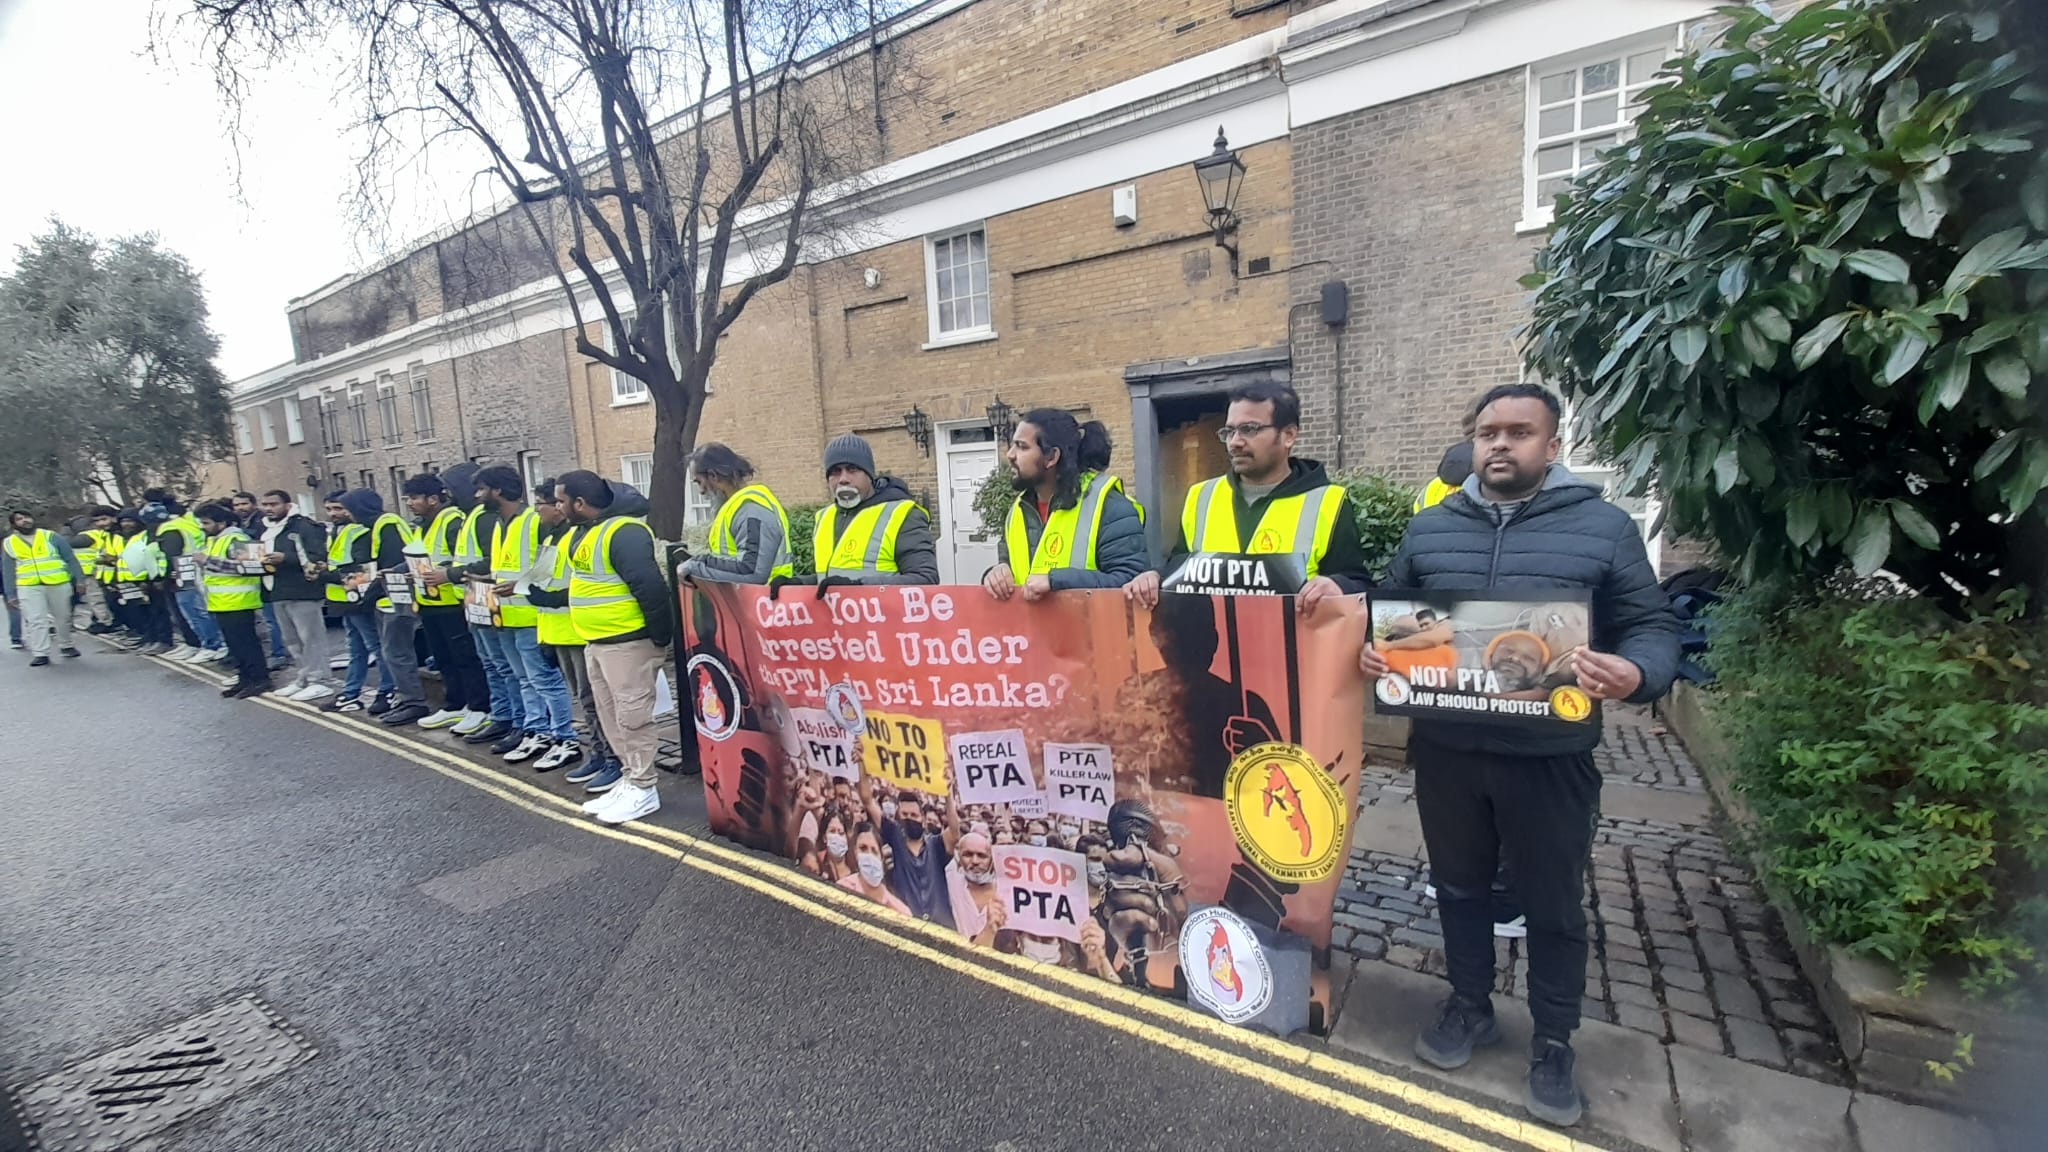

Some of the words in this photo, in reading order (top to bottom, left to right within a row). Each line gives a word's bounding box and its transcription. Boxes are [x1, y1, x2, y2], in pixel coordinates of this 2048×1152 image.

[1184, 558, 1223, 584] NOT
[1227, 559, 1269, 586] PTA
[756, 596, 813, 628] Can
[823, 592, 886, 625] You
[900, 587, 954, 623] Be
[896, 629, 1029, 666] Under
[776, 668, 831, 698] PTA
[929, 674, 1071, 709] Lanka?
[1409, 665, 1448, 688] NOT
[1457, 668, 1500, 693] PTA
[1409, 691, 1436, 707] LAW
[1436, 693, 1487, 712] SHOULD
[1490, 698, 1550, 716] PROTECT
[865, 717, 891, 745] NO
[895, 721, 926, 750] TO
[808, 740, 848, 769] PTA
[876, 745, 931, 783] PTA!
[958, 742, 1016, 760] REPEAL
[1059, 751, 1097, 767] PTA
[966, 763, 1026, 788] PTA
[1049, 769, 1085, 780] KILLER
[1088, 771, 1112, 782] LAW
[1059, 784, 1108, 806] PTA
[1004, 856, 1076, 887] STOP
[1260, 859, 1309, 878] GOVERNMENT
[1013, 886, 1075, 925] PTA
